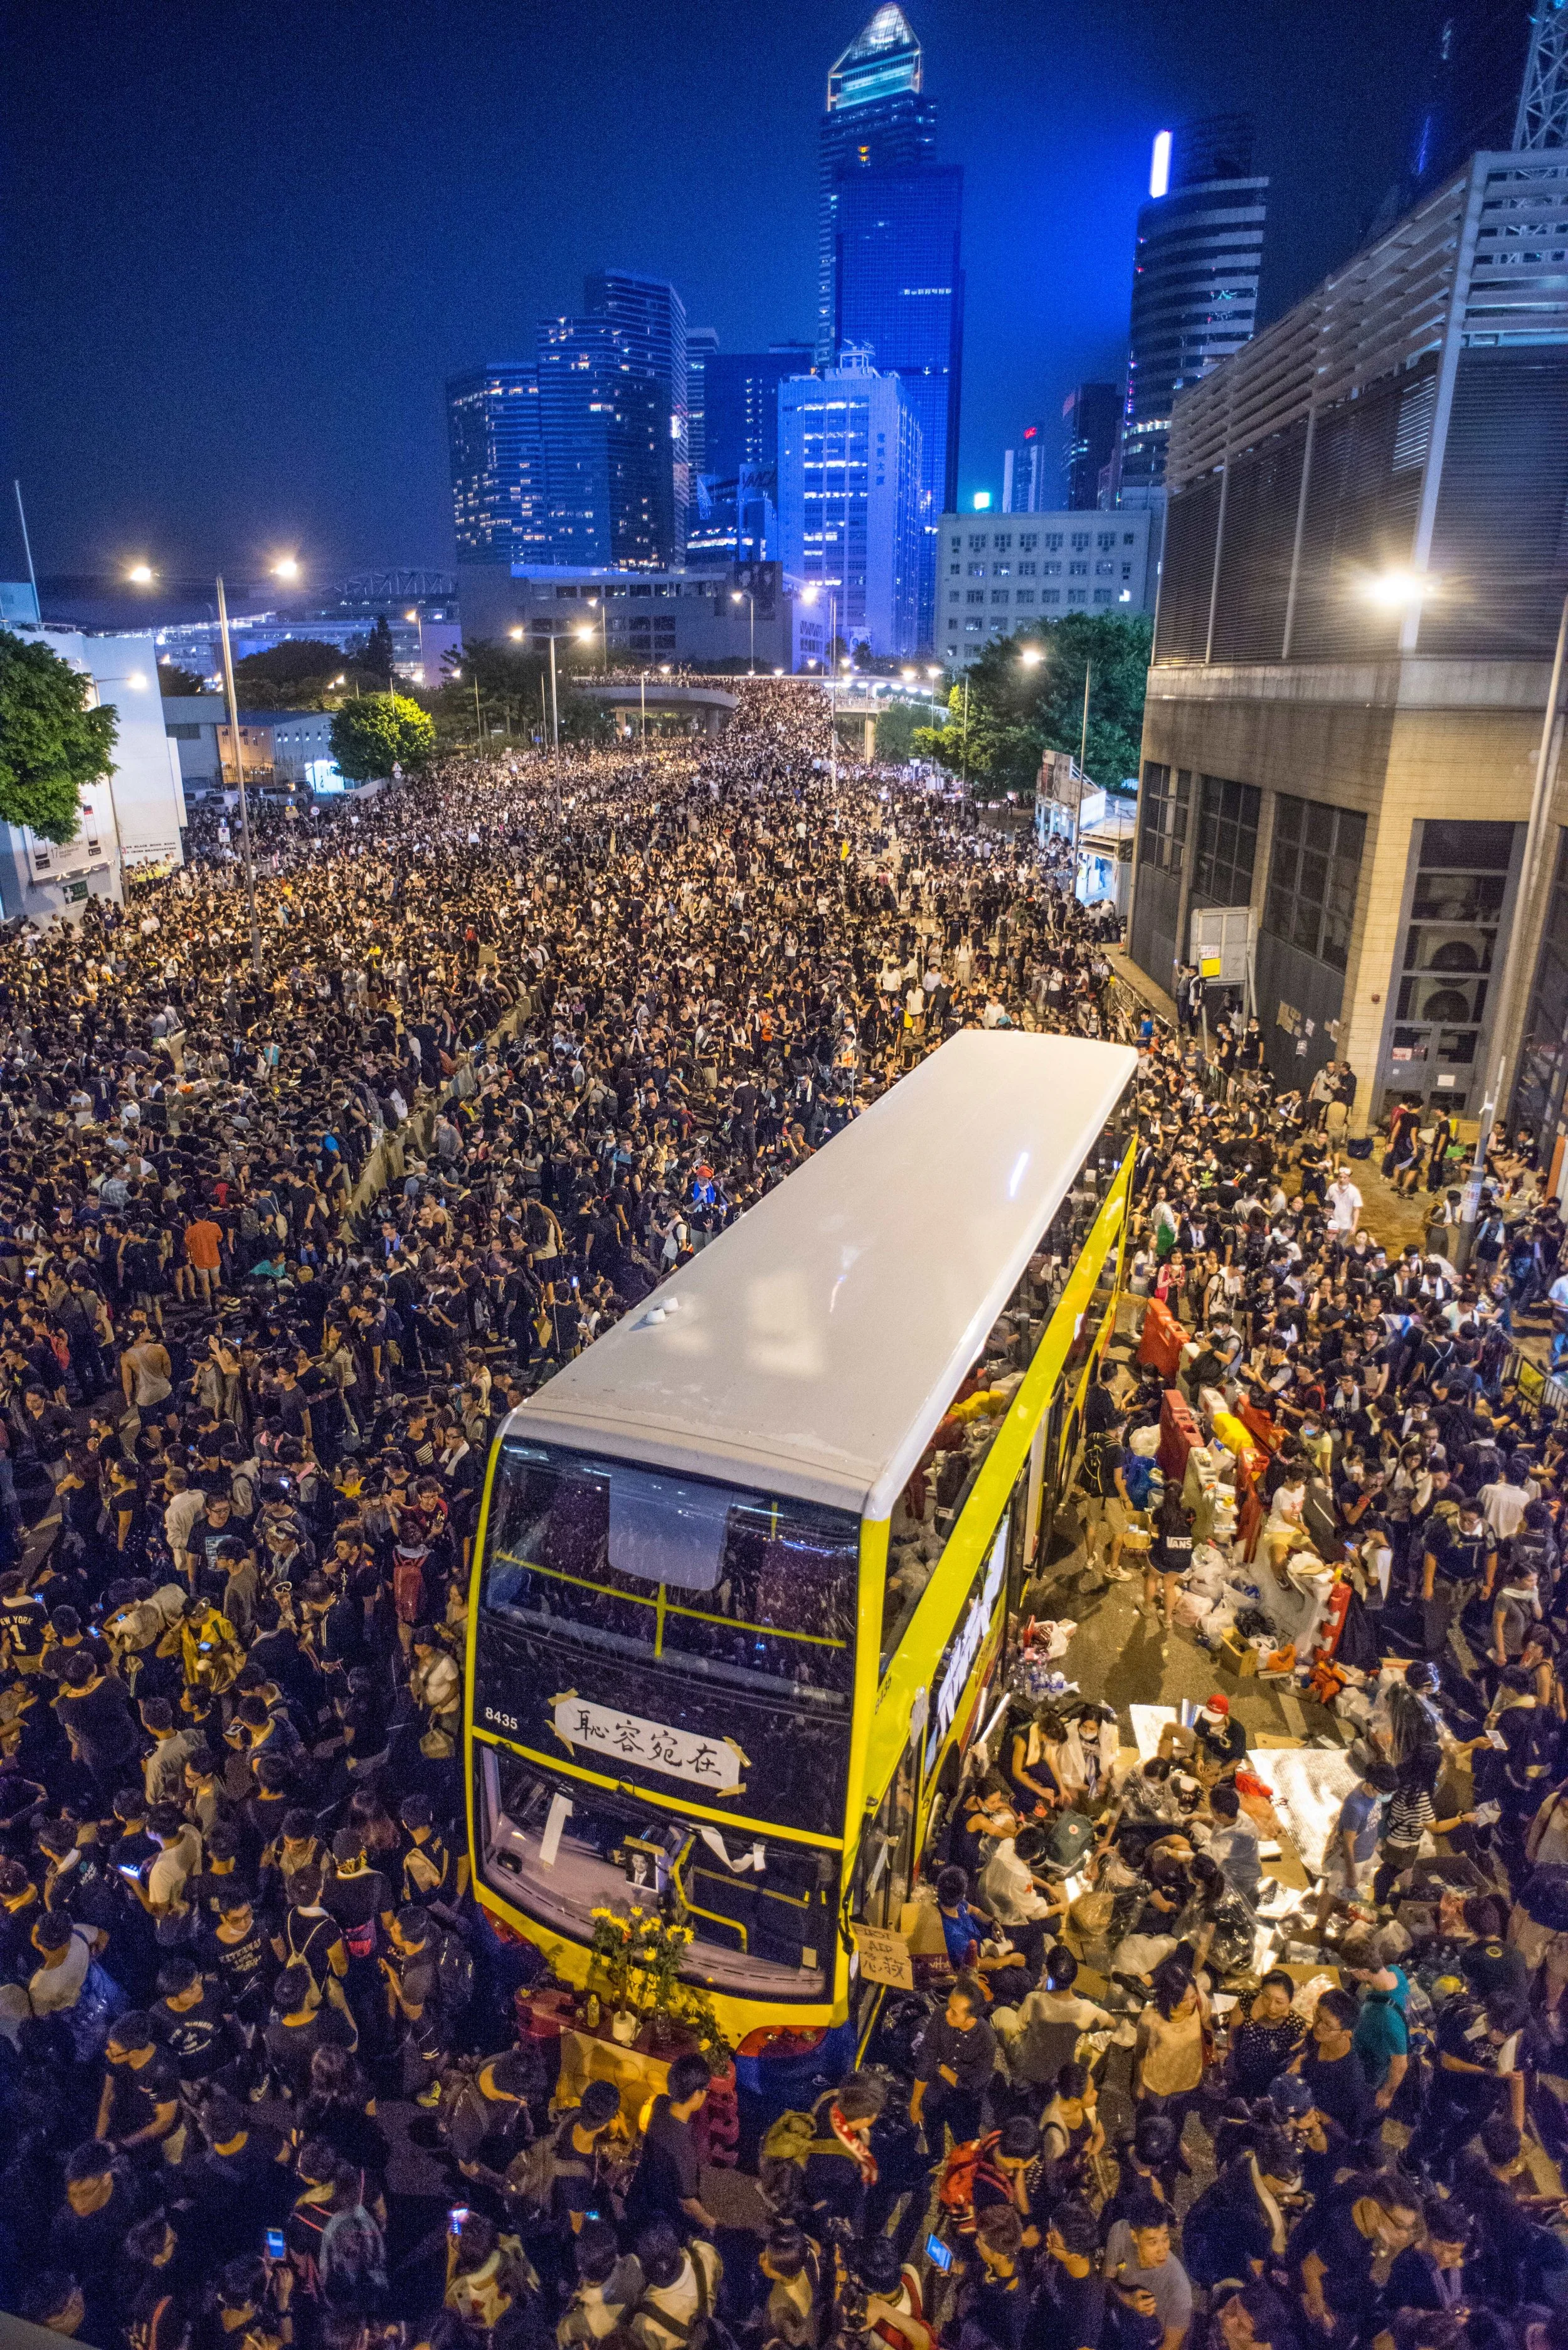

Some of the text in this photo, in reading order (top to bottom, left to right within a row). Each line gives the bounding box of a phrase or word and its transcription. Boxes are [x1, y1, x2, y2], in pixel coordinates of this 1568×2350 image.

[1167, 1536, 1192, 1549] VANS
[0, 1615, 34, 1625] EW YORK
[9, 1625, 26, 1651] 1
[874, 1671, 892, 1715] 8435
[485, 1706, 518, 1730] 8435
[573, 1709, 722, 1777] 恥容宛在
[853, 1925, 891, 1940] FIRST
[863, 1951, 904, 1980] 急救
